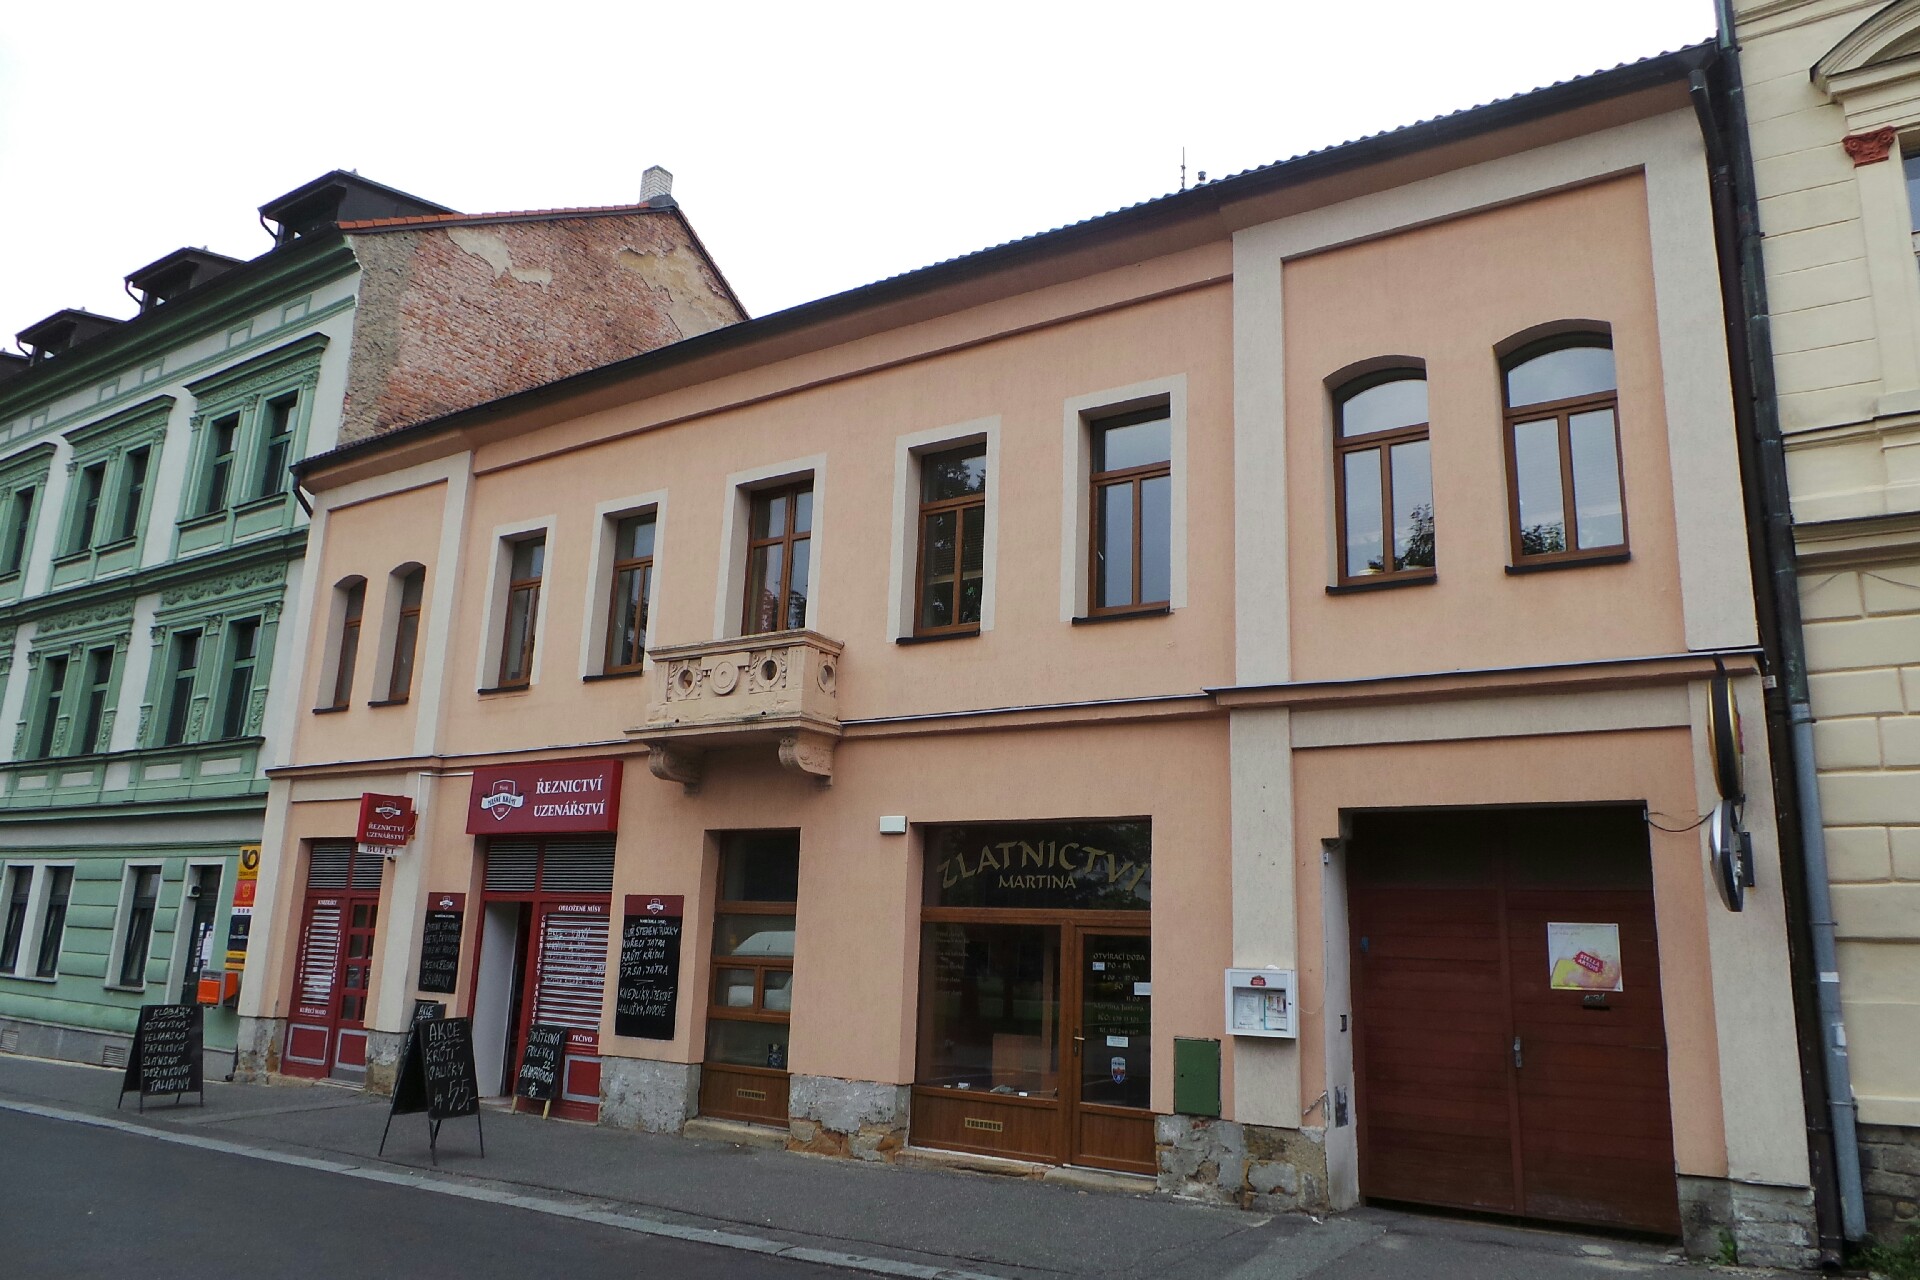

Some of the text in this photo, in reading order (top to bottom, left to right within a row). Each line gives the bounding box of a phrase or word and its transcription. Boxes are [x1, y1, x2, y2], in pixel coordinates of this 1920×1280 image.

[535, 774, 603, 794] ŘEZNICTVÍ
[533, 799, 605, 817] UZENÁŘSTVÍ
[368, 822, 405, 832] ŘEZNICTVÍ
[366, 832, 404, 840] UZENÁŘSTVÍ
[366, 845, 395, 854] BUFET
[998, 875, 1077, 889] MARTINA
[558, 904, 602, 912] OBLOŽENÉ MÍSY
[1093, 952, 1125, 960] OTVÍRACÍ
[1580, 953, 1600, 966] STELLA
[1122, 961, 1131, 969] PÁ
[1577, 959, 1599, 972] ARTOIS
[1114, 982, 1123, 990] SO
[429, 1021, 461, 1041] AKCE
[572, 1034, 593, 1043] PEČIVO
